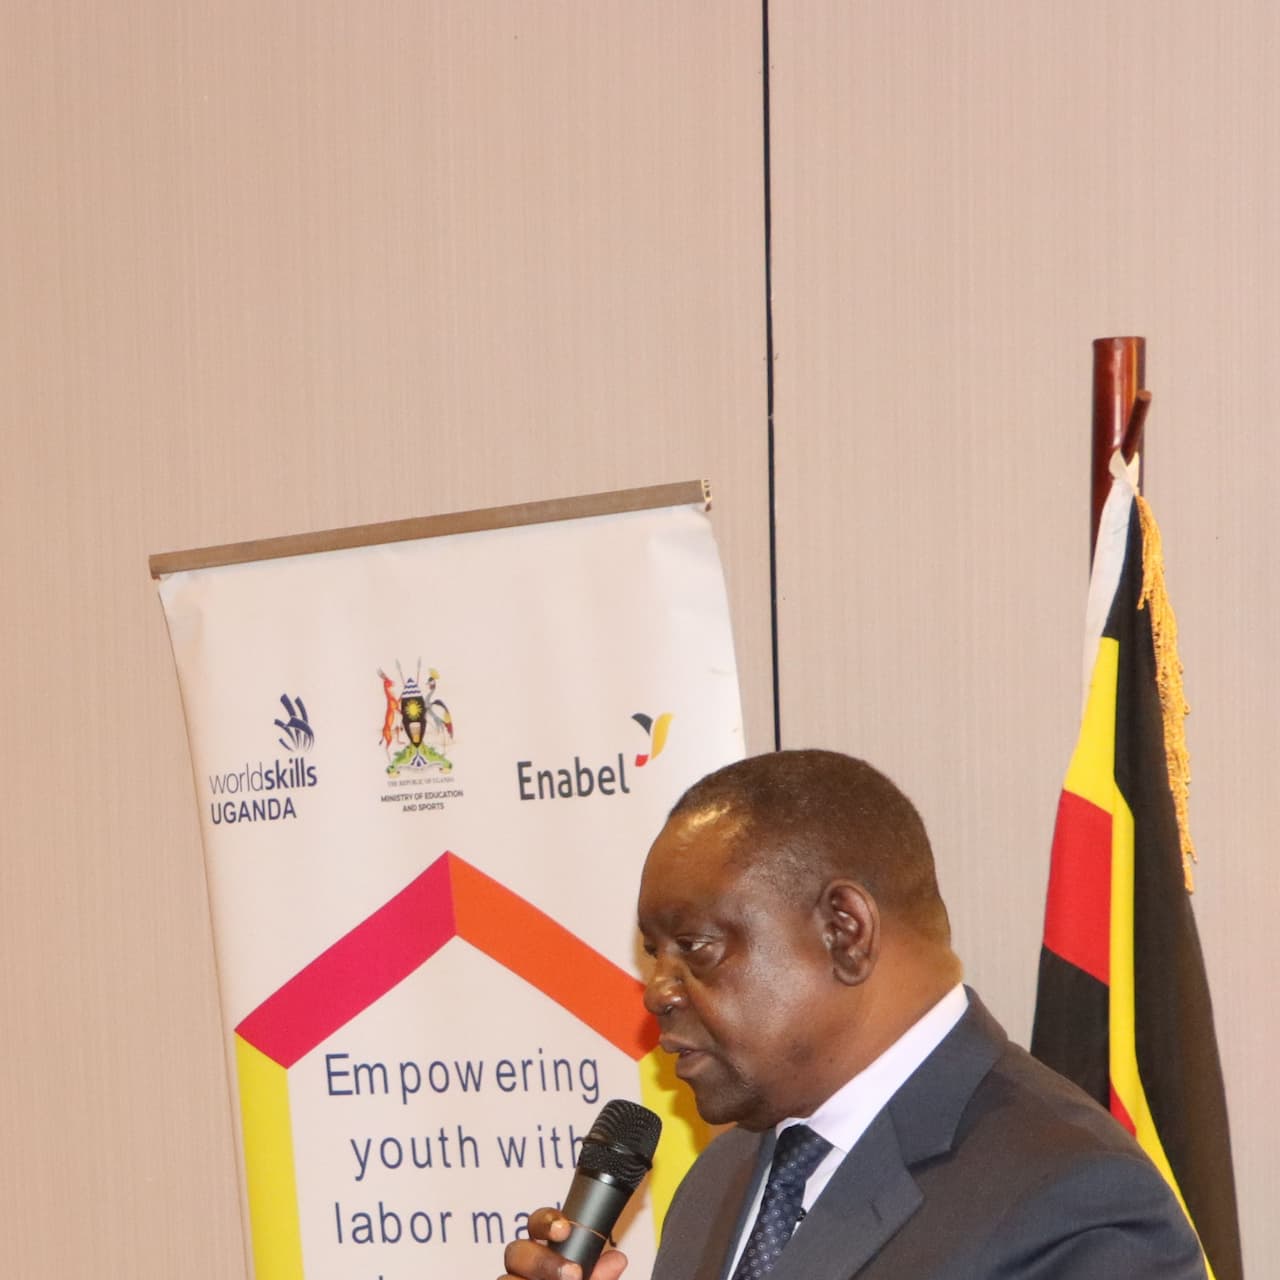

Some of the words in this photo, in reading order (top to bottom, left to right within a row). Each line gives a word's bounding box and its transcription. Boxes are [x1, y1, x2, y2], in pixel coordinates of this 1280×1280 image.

[209, 757, 317, 795] worldskills
[380, 793, 412, 802] MINISTRY
[424, 790, 464, 799] EDUCATION
[517, 753, 630, 801] Enabel
[211, 797, 297, 824] UGANDA
[403, 804, 417, 812] AND
[418, 802, 444, 811] SPORTS
[325, 1048, 600, 1105] Empowering
[350, 1125, 480, 1181] youth
[497, 1124, 584, 1168] with
[335, 1201, 452, 1244] labor
